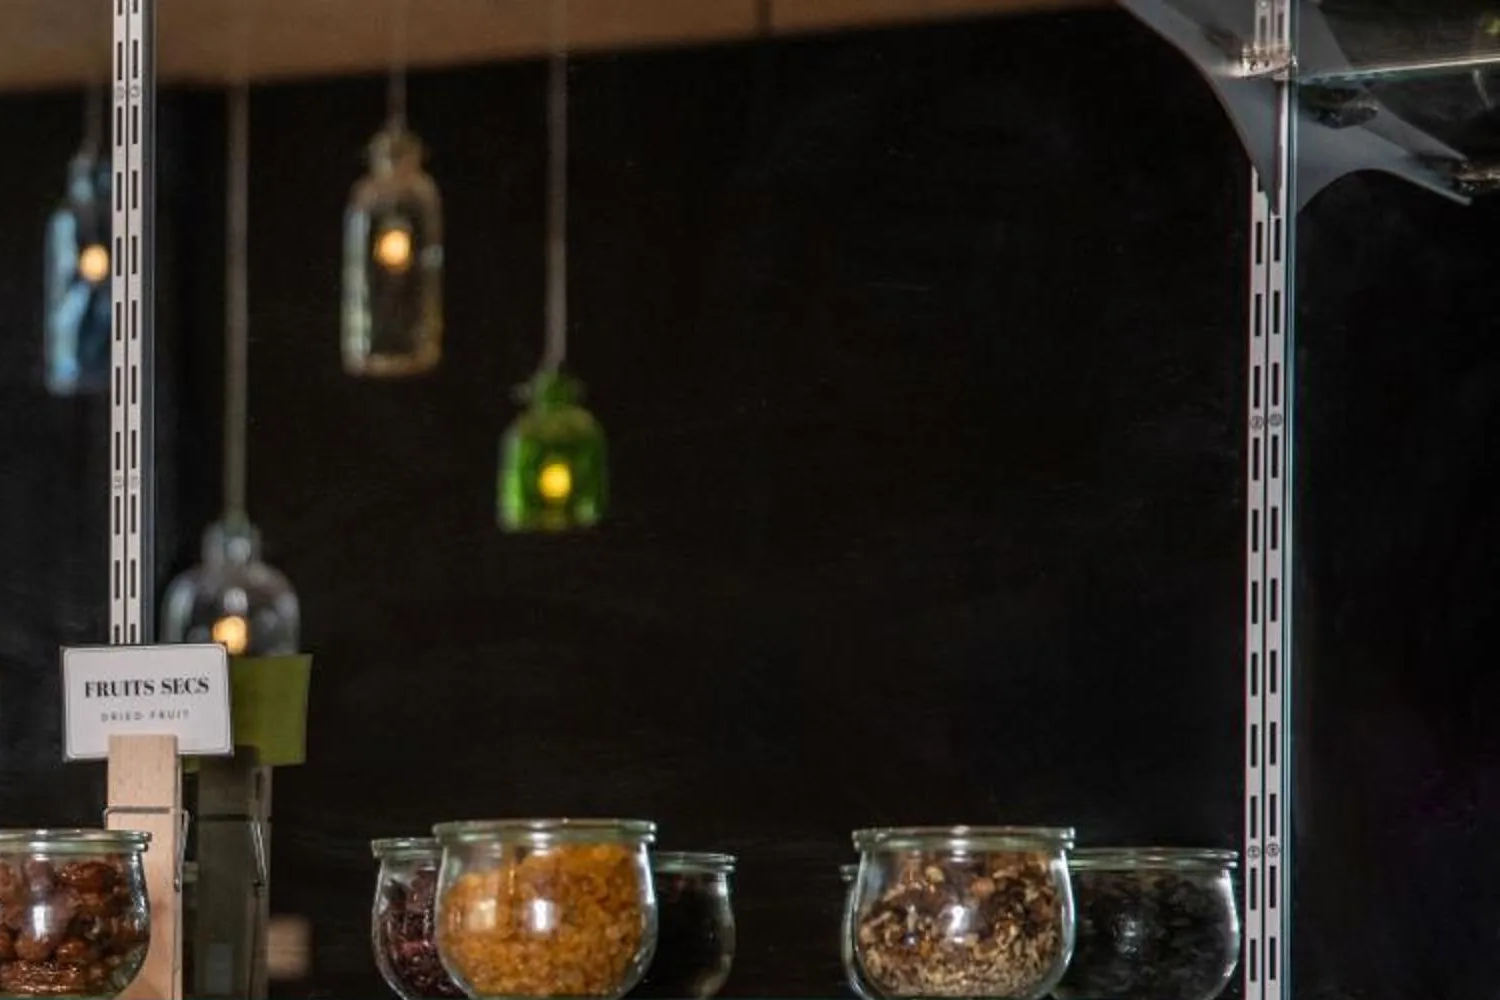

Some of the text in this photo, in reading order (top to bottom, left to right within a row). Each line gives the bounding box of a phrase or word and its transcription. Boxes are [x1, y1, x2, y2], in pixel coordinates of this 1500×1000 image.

[84, 676, 210, 699] FRUITS SECS
[101, 708, 190, 722] DRIED FRUIT
